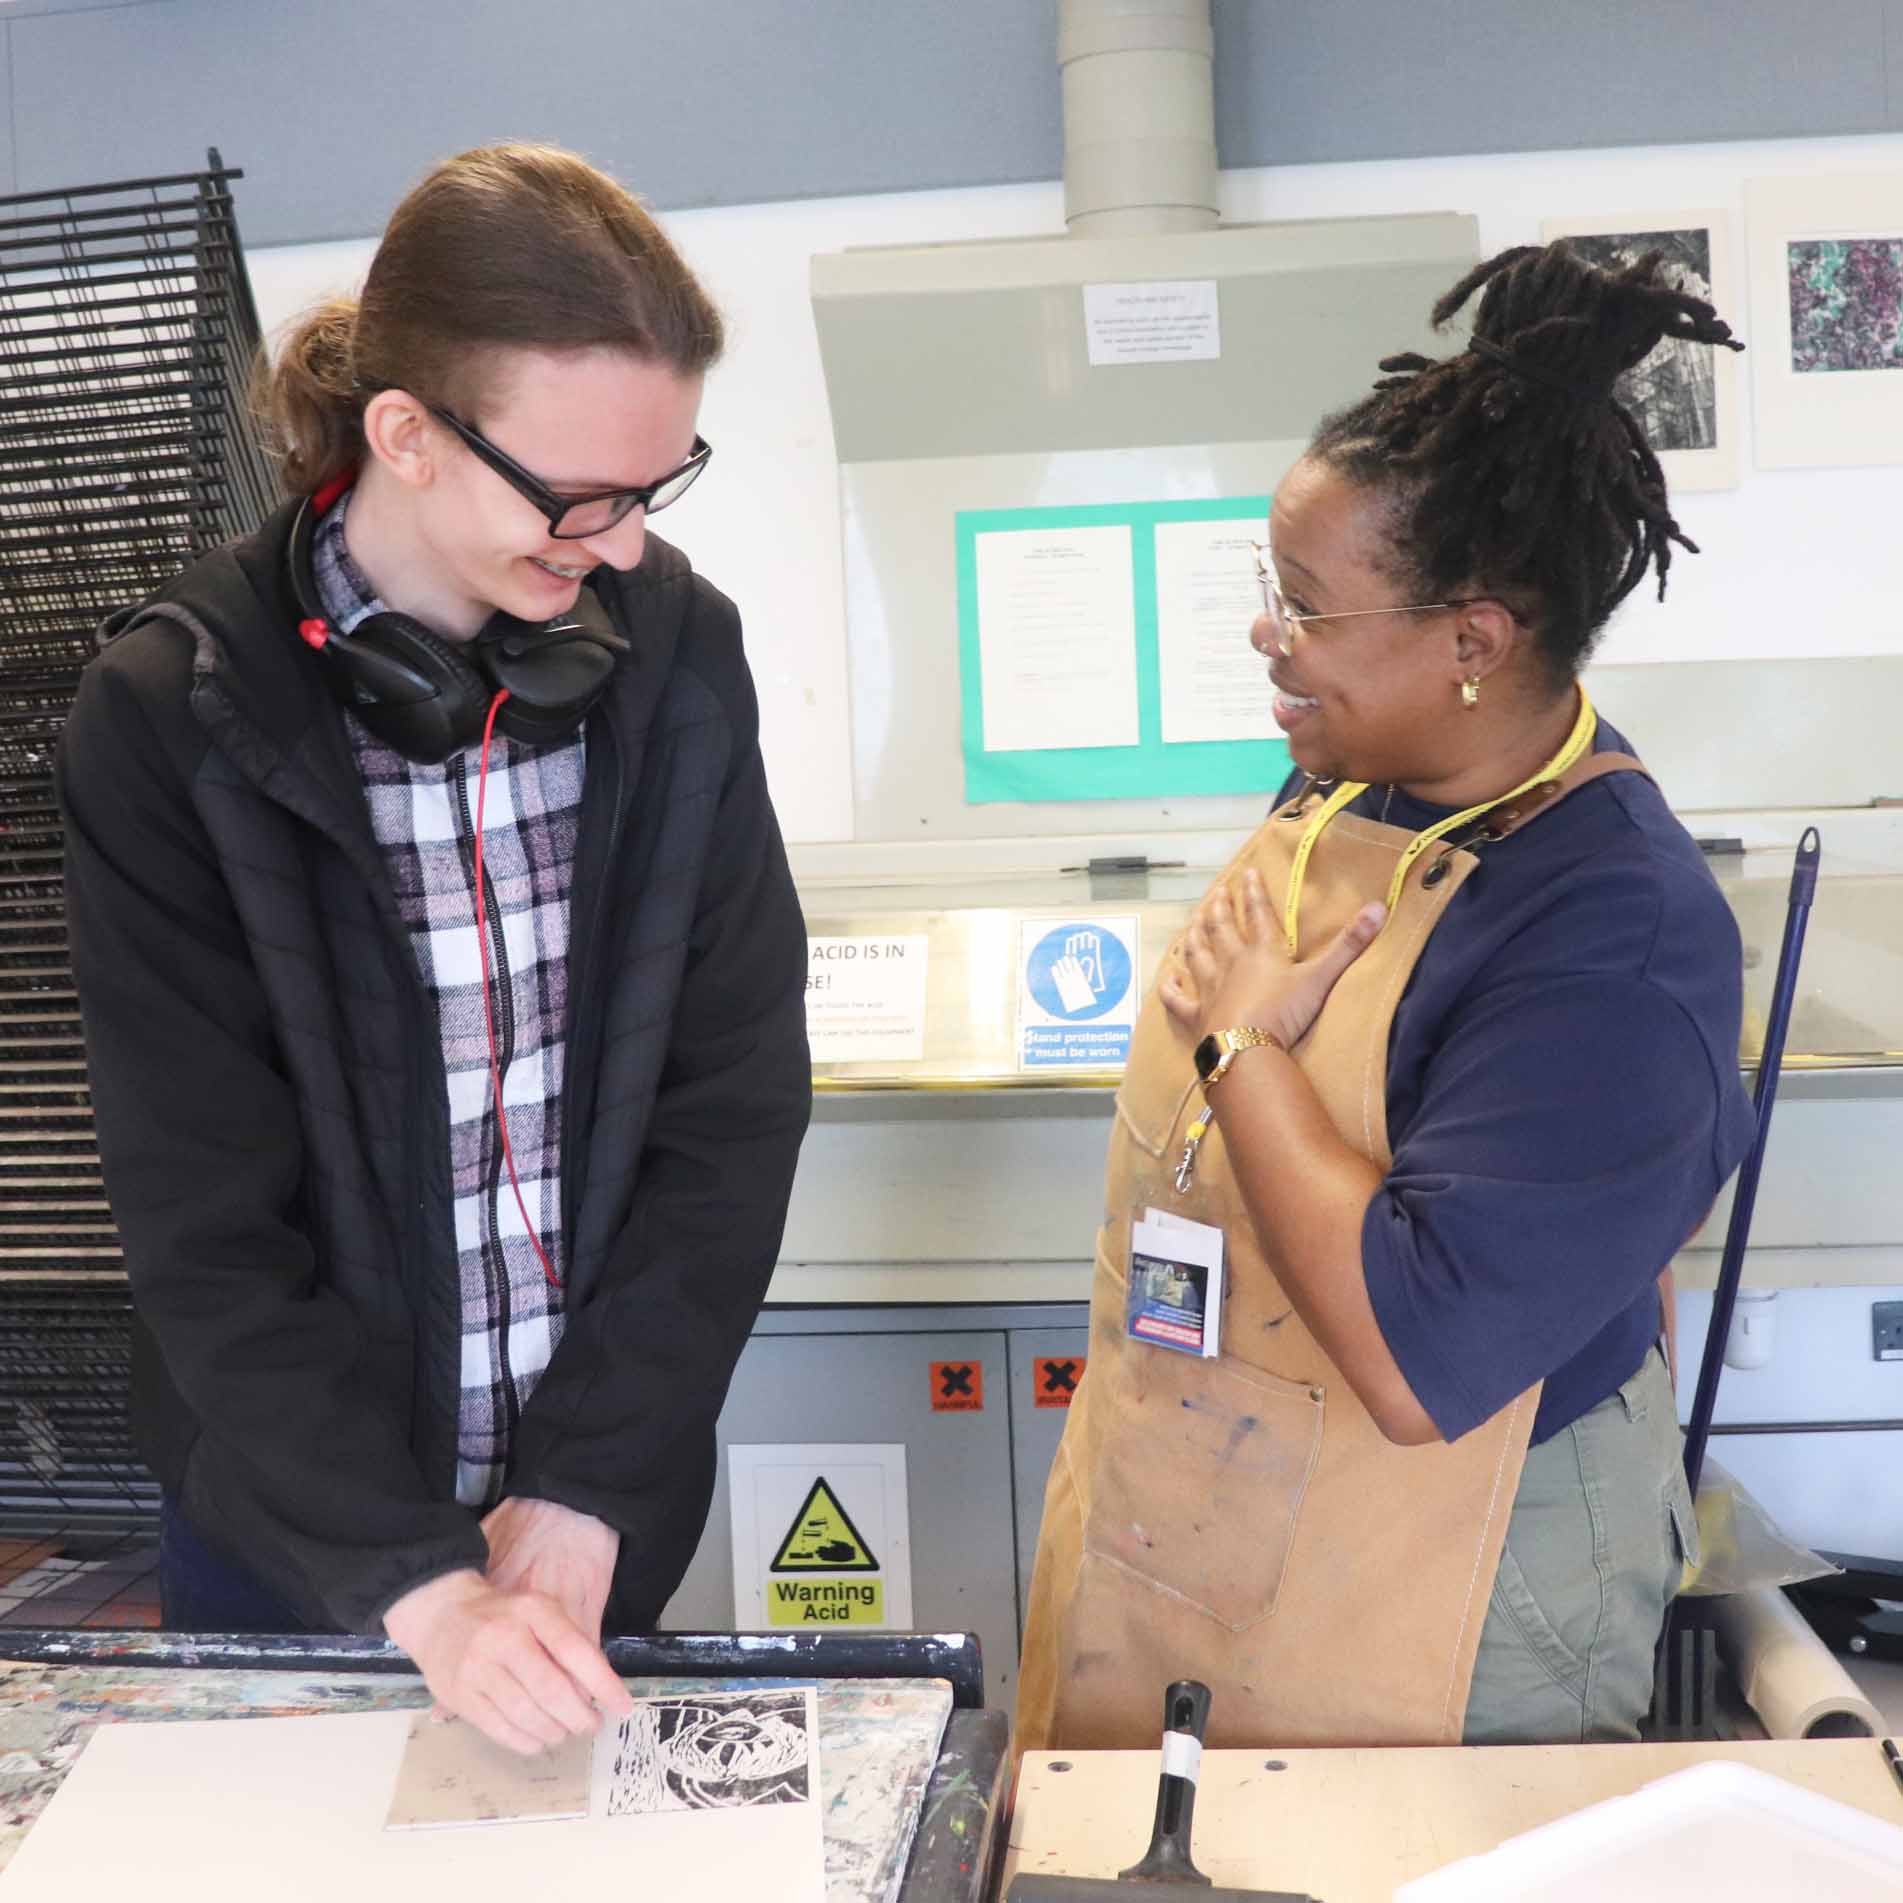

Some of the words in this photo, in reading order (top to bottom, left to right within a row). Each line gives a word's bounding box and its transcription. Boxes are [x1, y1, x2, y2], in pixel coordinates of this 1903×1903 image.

[812, 945, 857, 960] ACID
[864, 944, 879, 959] IS
[885, 944, 905, 958] IN
[1064, 1031, 1129, 1044] protection
[1035, 1047, 1066, 1057] must
[1069, 1047, 1086, 1057] be
[1088, 1047, 1121, 1057] worn
[776, 1581, 875, 1605] Warning
[803, 1603, 849, 1620] Acid
